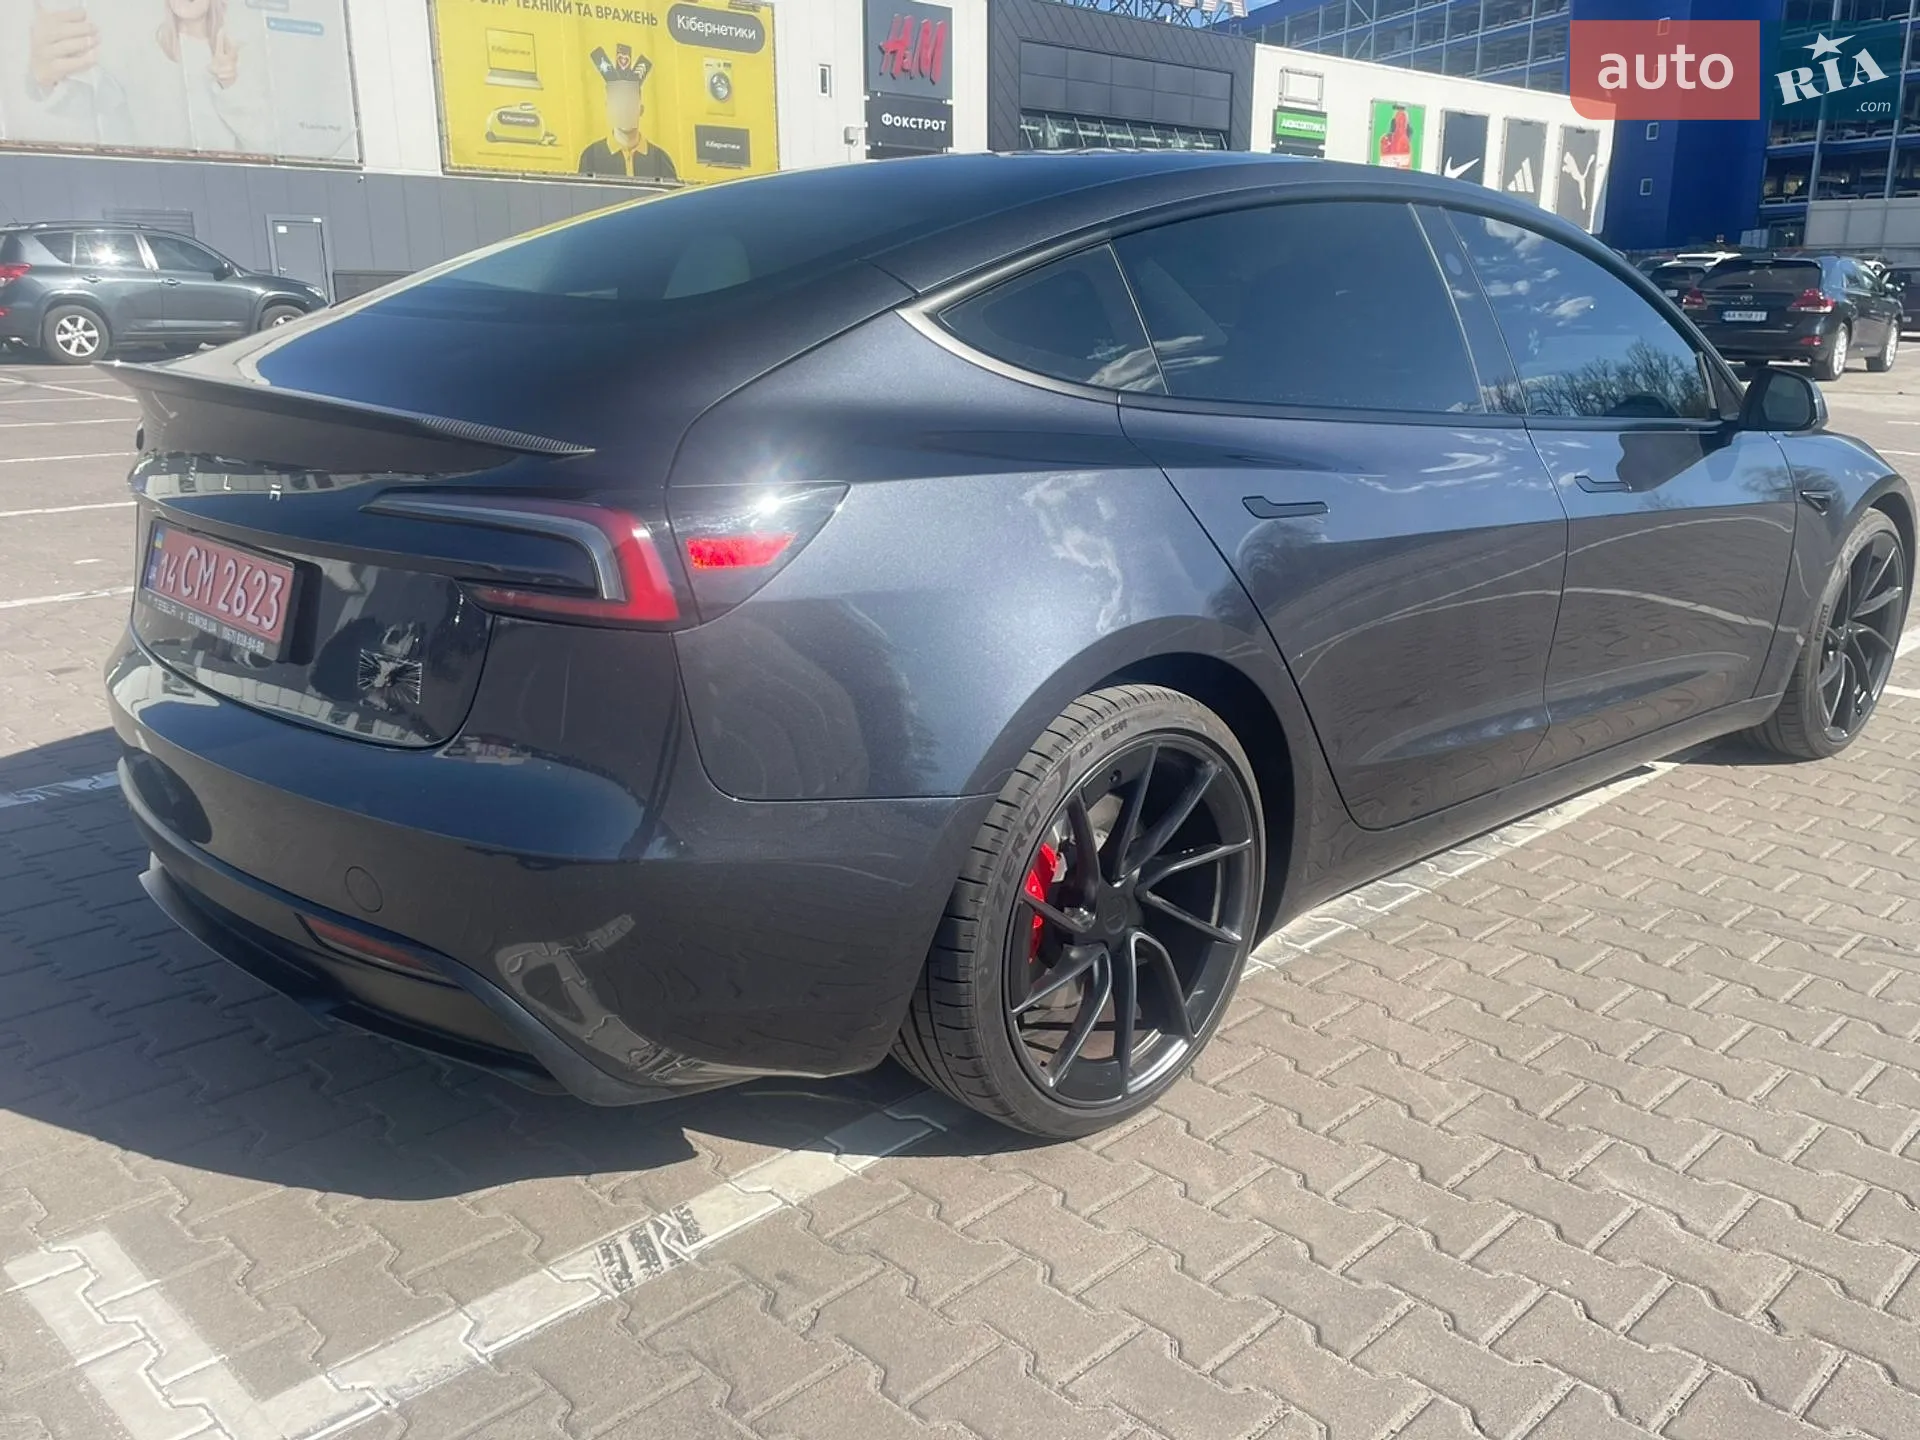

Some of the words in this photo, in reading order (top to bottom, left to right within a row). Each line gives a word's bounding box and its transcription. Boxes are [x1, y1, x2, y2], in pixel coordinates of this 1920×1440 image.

[577, 3, 593, 18] ТА
[596, 8, 659, 27] ВРАЖЕНЬ
[676, 14, 757, 41] Кібернетики
[878, 13, 948, 86] H&M
[881, 112, 947, 132] ФОКСТРОТ
[160, 552, 180, 593] 14
[181, 545, 219, 605] CM
[217, 558, 285, 631] 2623
